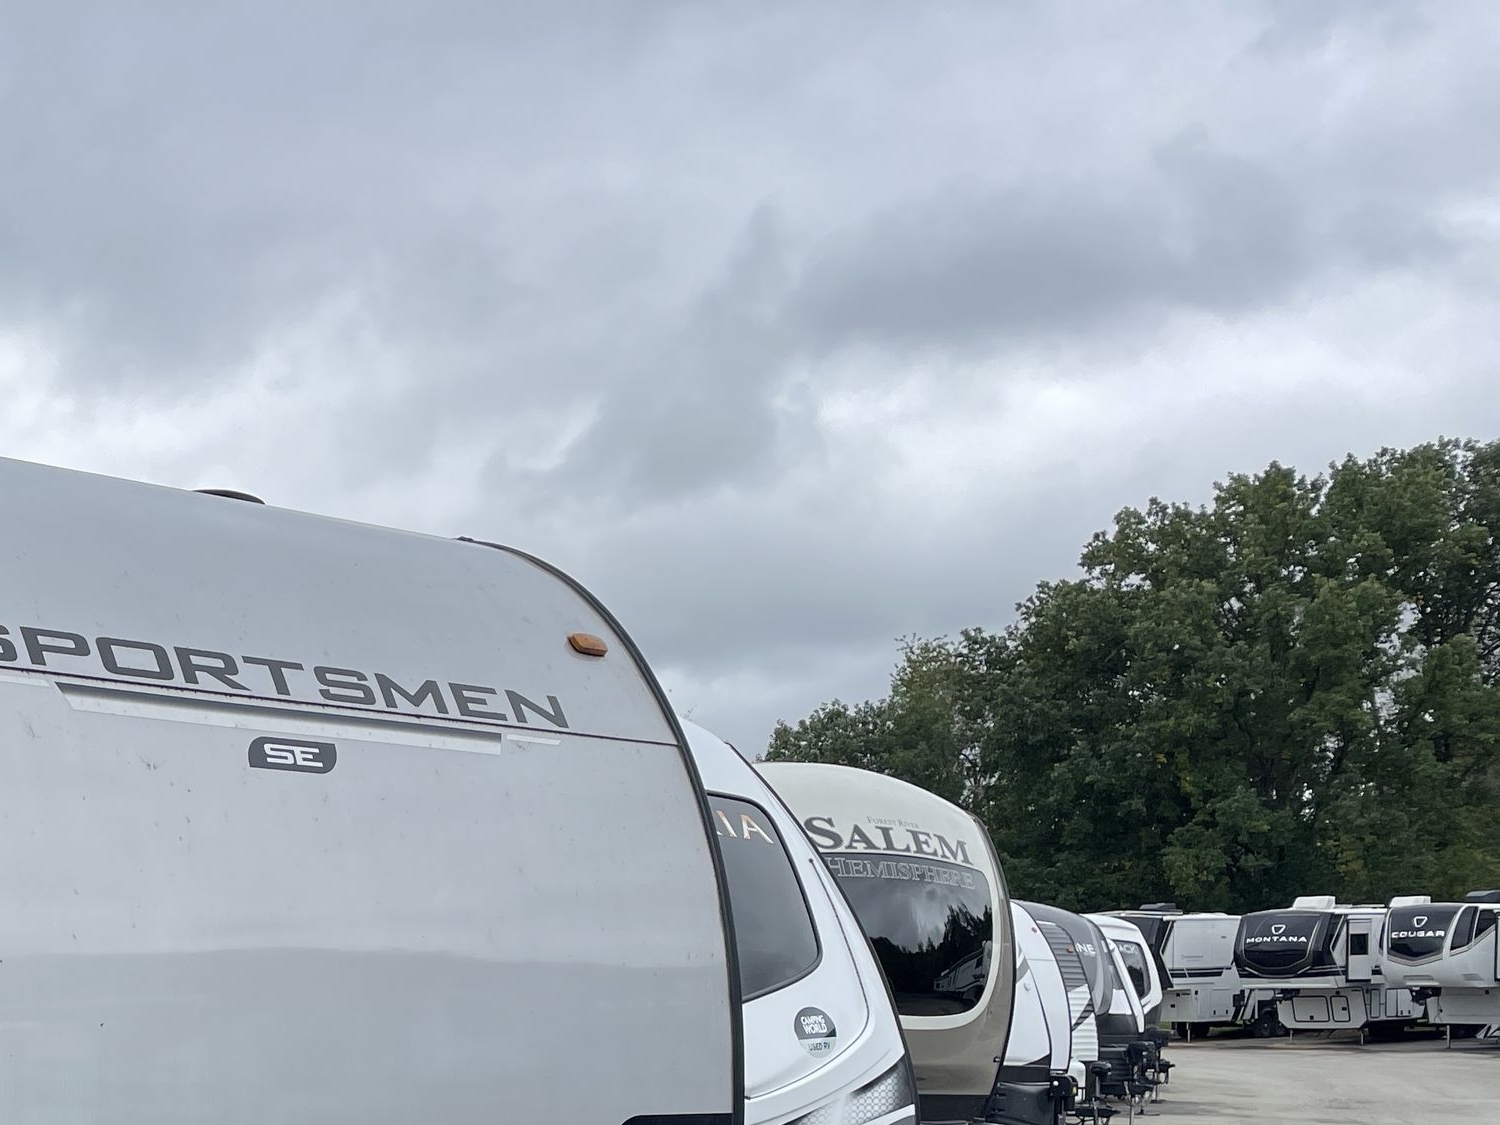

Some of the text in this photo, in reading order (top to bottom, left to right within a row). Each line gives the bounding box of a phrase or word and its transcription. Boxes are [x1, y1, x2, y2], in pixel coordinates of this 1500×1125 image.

[263, 743, 324, 768] SE
[804, 816, 974, 866] SALEM
[826, 857, 975, 890] HEMISPHERE
[1246, 935, 1308, 944] MONTANA
[1391, 930, 1446, 939] COUGAR
[803, 1023, 828, 1034] WORLD
